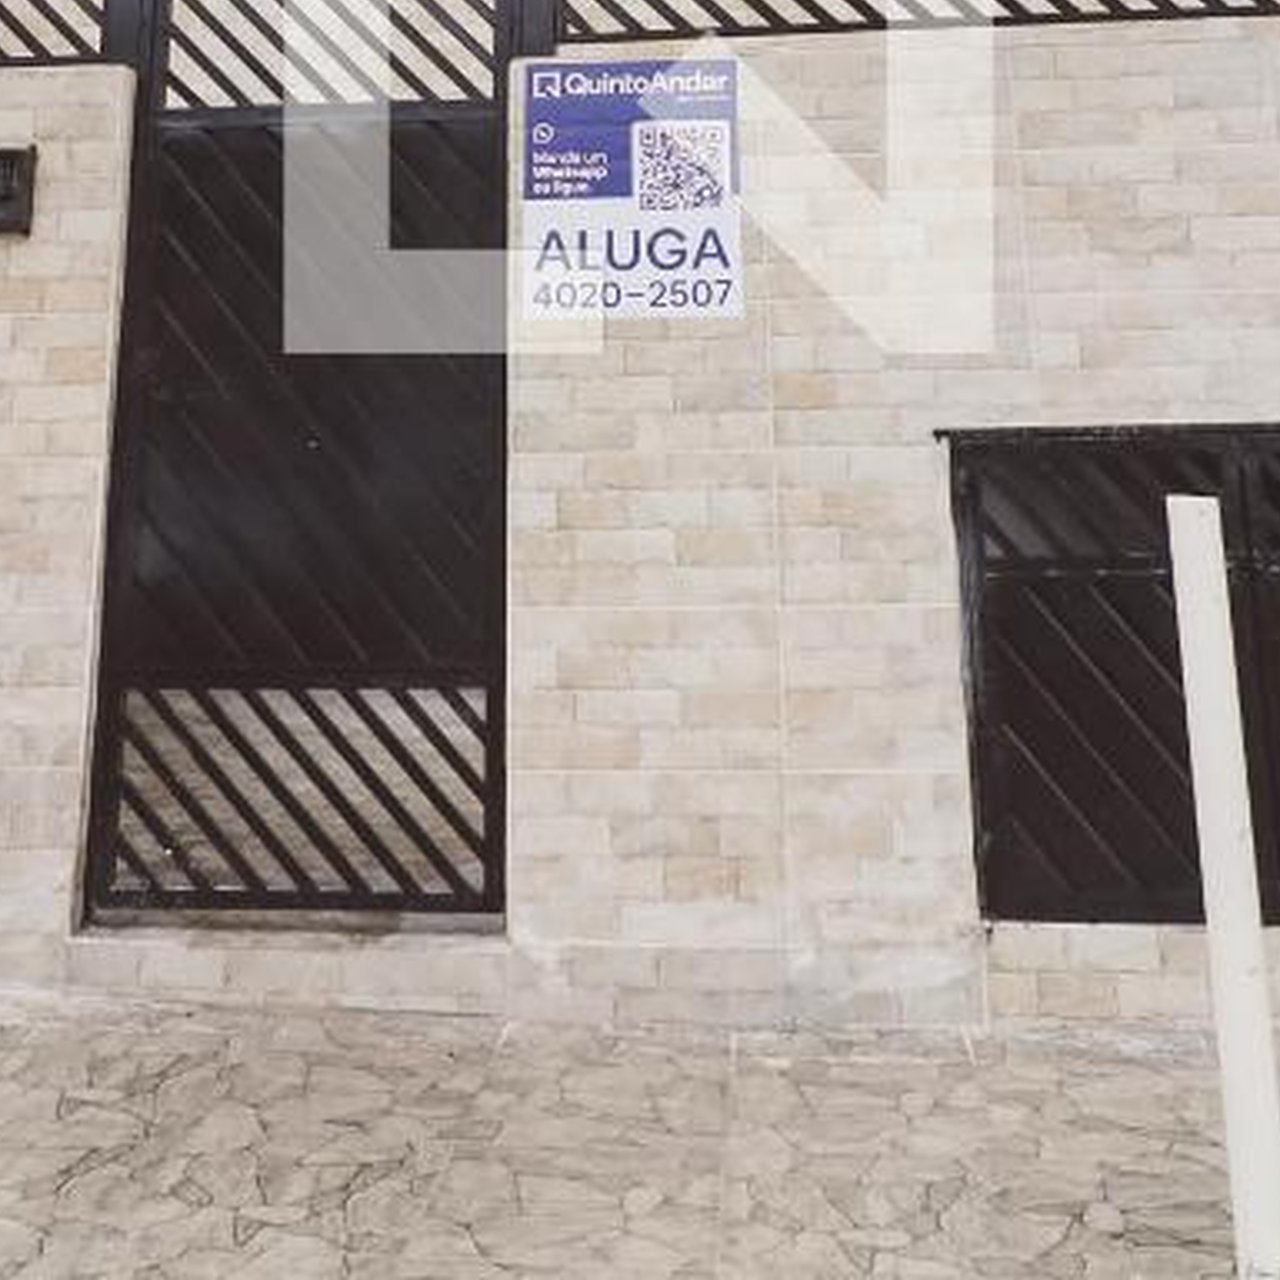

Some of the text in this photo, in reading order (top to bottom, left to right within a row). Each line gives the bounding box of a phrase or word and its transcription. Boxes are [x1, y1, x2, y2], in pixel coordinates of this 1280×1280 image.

[565, 70, 730, 96] QuintoAndar
[534, 227, 731, 272] ALUGA
[533, 279, 732, 309] 4020-2507
